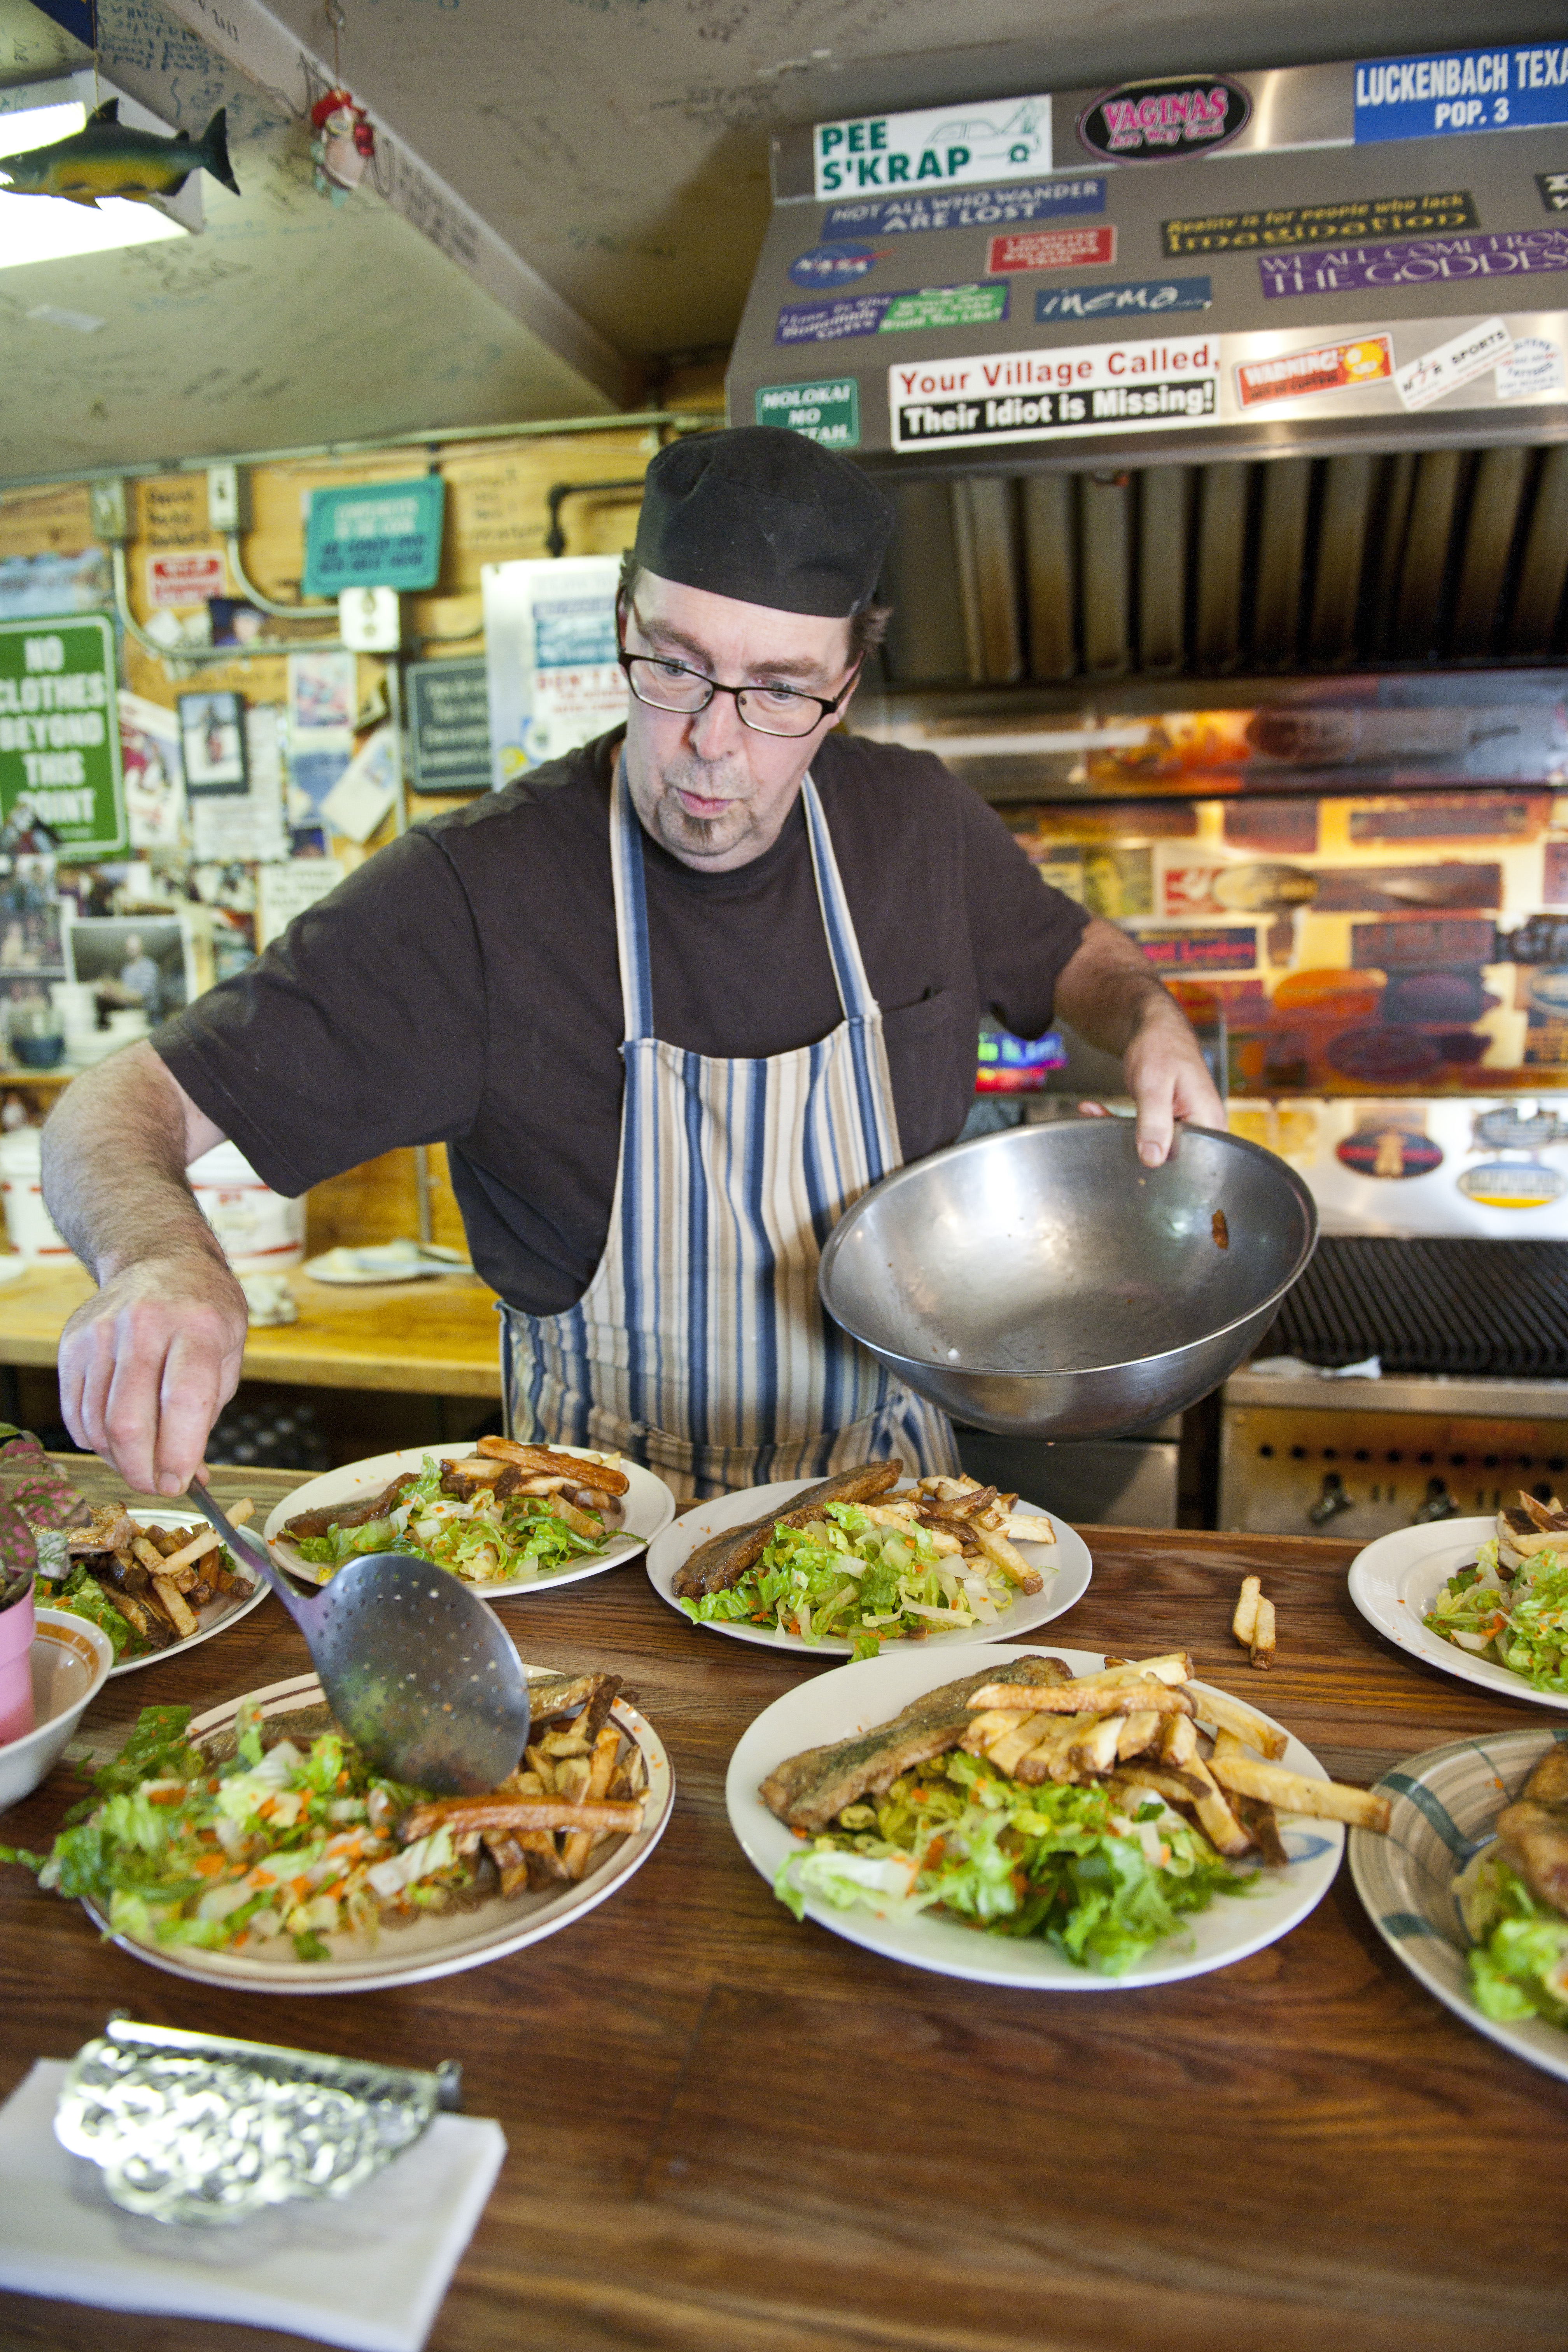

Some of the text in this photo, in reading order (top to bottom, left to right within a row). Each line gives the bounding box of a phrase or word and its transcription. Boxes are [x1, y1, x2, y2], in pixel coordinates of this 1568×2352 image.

[1356, 53, 1509, 107] LUCKENBACH
[1101, 87, 1228, 131] VAGINAS
[1434, 96, 1510, 130] POP. 3
[820, 120, 889, 156] PEE
[822, 145, 971, 191] S'KRAP
[831, 179, 1101, 225] NOT ALL WHO WANDER
[881, 201, 1040, 233] ARE LOST
[1167, 216, 1238, 234] Reality
[1264, 210, 1296, 225] for
[1373, 198, 1418, 214] who
[1421, 194, 1465, 211] lack
[795, 256, 870, 276] NASA
[1263, 248, 1568, 295] THE GODDES
[1321, 249, 1377, 268] ALL
[1384, 238, 1475, 261] COME
[1451, 330, 1505, 364] SPORTS
[901, 343, 1220, 395] Your Village Called,
[1244, 349, 1339, 388] WARNING!
[762, 384, 851, 410] MOLOKAI
[903, 381, 1213, 435] Their Idiot is Missing!
[788, 408, 822, 427] NO
[24, 635, 65, 673] NO
[0, 710, 104, 751] BEYOND
[22, 750, 85, 789] THIS
